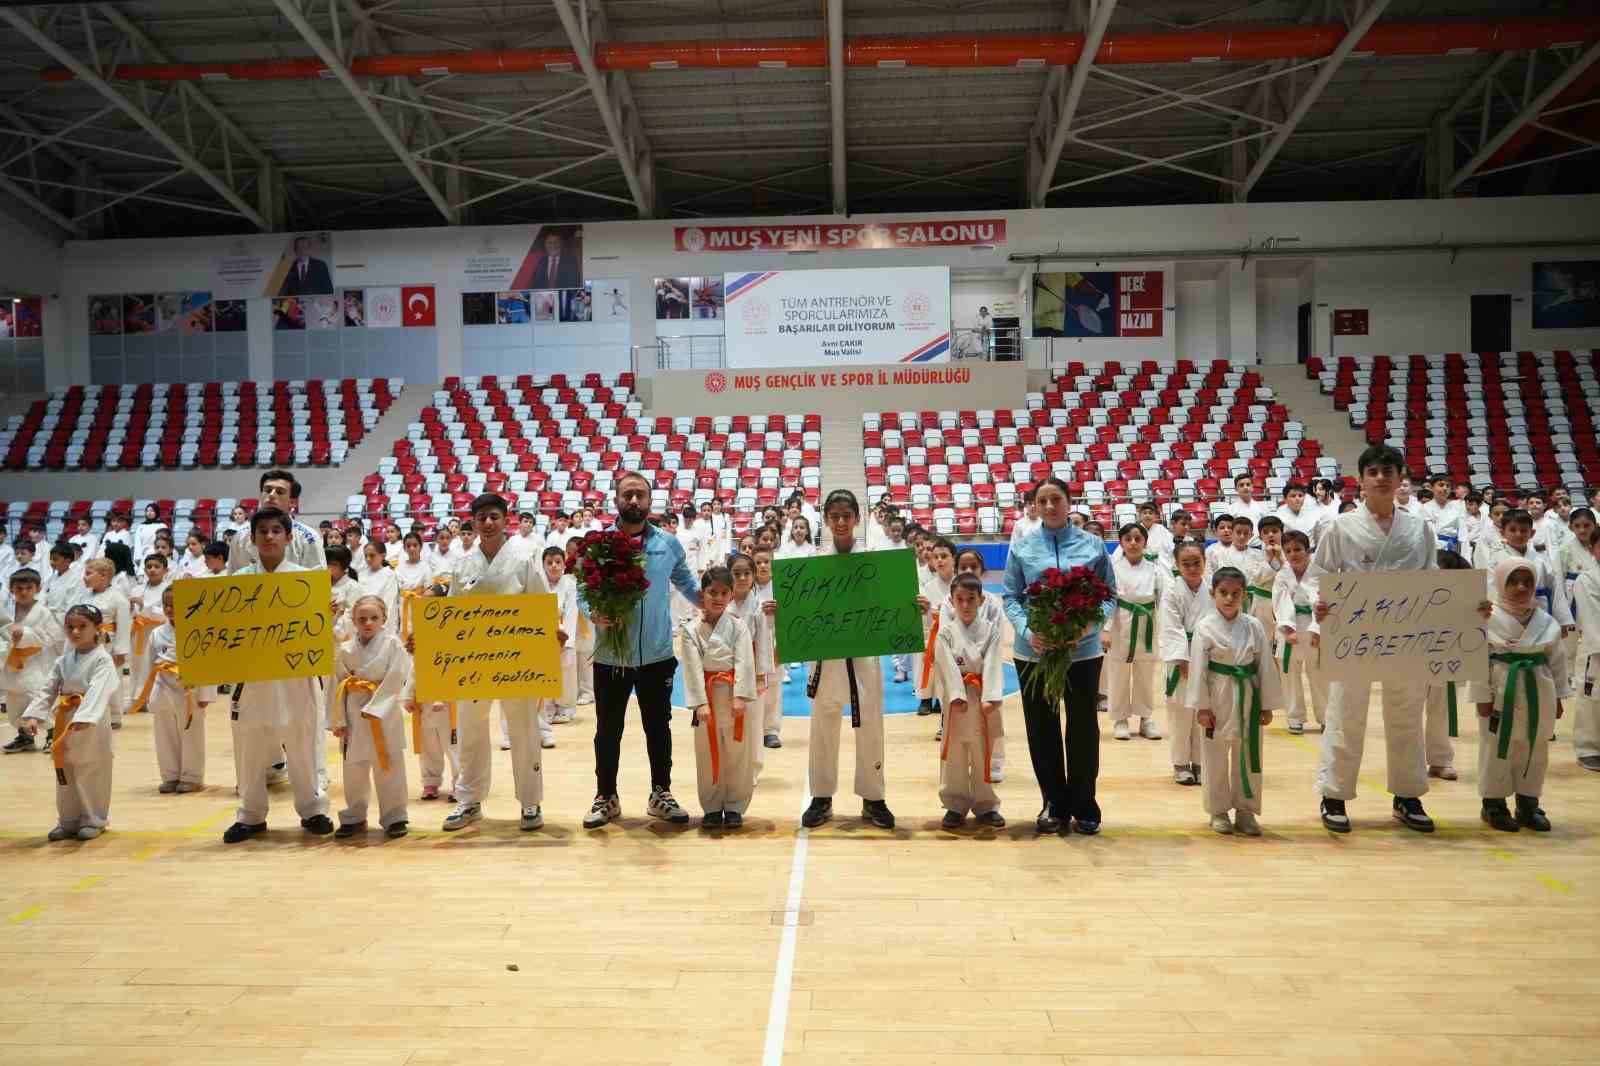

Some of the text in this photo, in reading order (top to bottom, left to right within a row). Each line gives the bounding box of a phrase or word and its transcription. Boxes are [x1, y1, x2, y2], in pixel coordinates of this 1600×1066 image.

[709, 223, 994, 251] MUŞ YENİ SPOR SALONU
[780, 294, 893, 310] TÜM ANTRENÖR VE
[784, 308, 889, 321] SPORCULARIMIZA
[778, 323, 836, 336] BAŞARILAR
[837, 320, 896, 333] DİLİYORUM
[734, 367, 971, 392] MUŞ GENÇLİK VE SPOR İL MÜDÜRLÜĞÜ
[433, 650, 521, 678] öğretmenin
